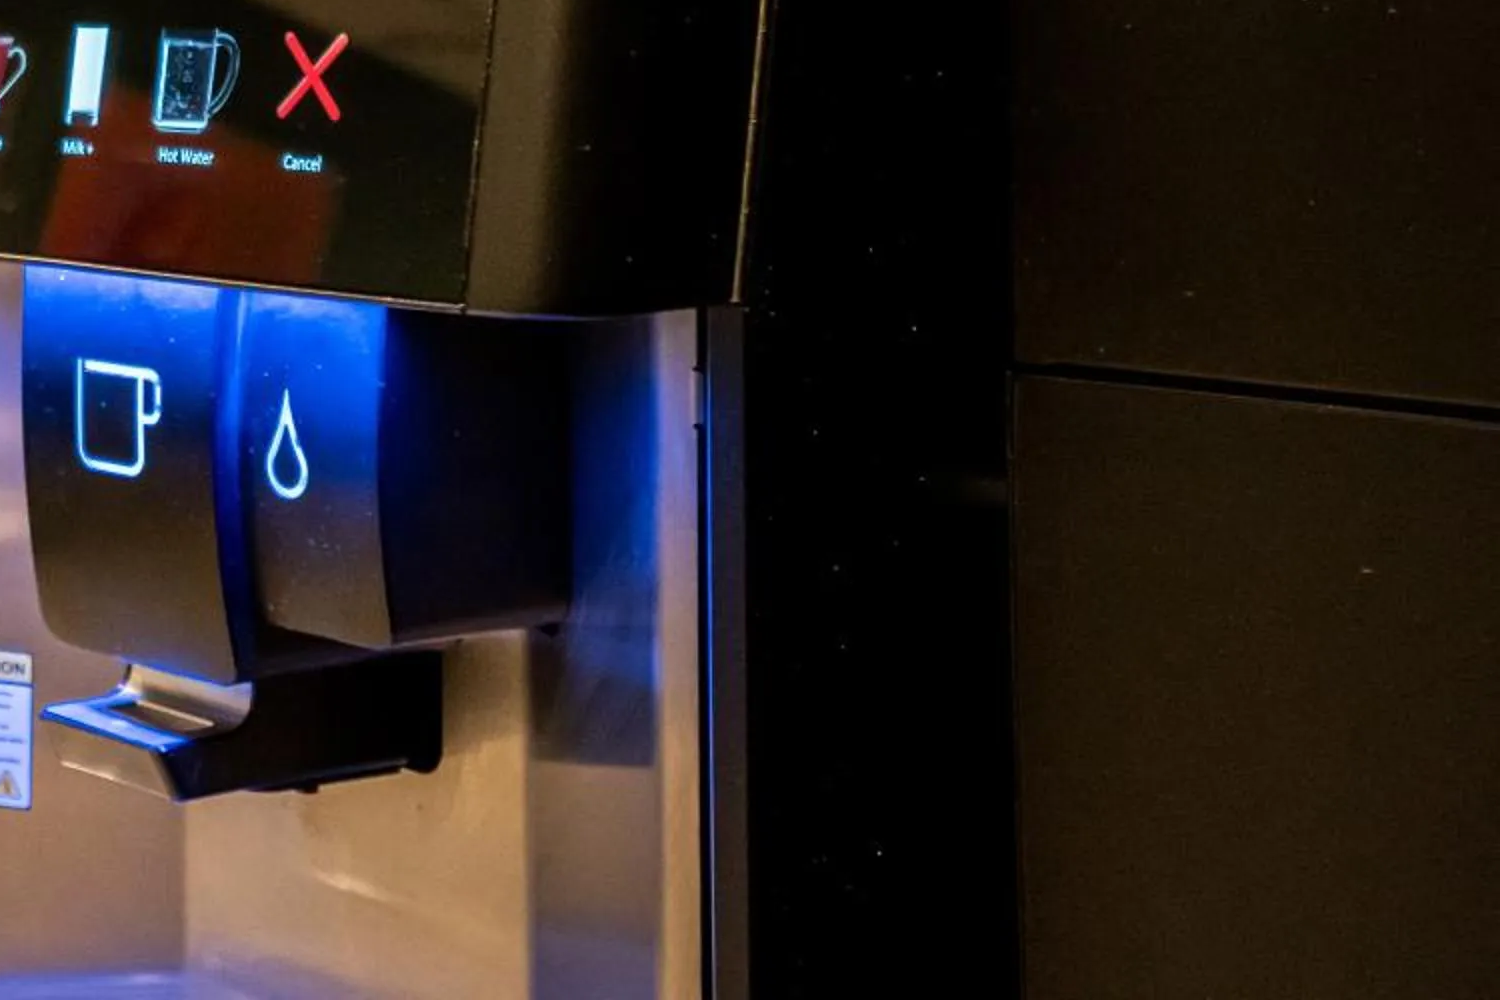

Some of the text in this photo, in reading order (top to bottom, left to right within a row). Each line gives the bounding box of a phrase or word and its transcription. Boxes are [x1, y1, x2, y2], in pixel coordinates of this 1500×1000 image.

[62, 139, 86, 156] Milk
[157, 147, 215, 166] Hot Water
[283, 154, 323, 173] Cancel
